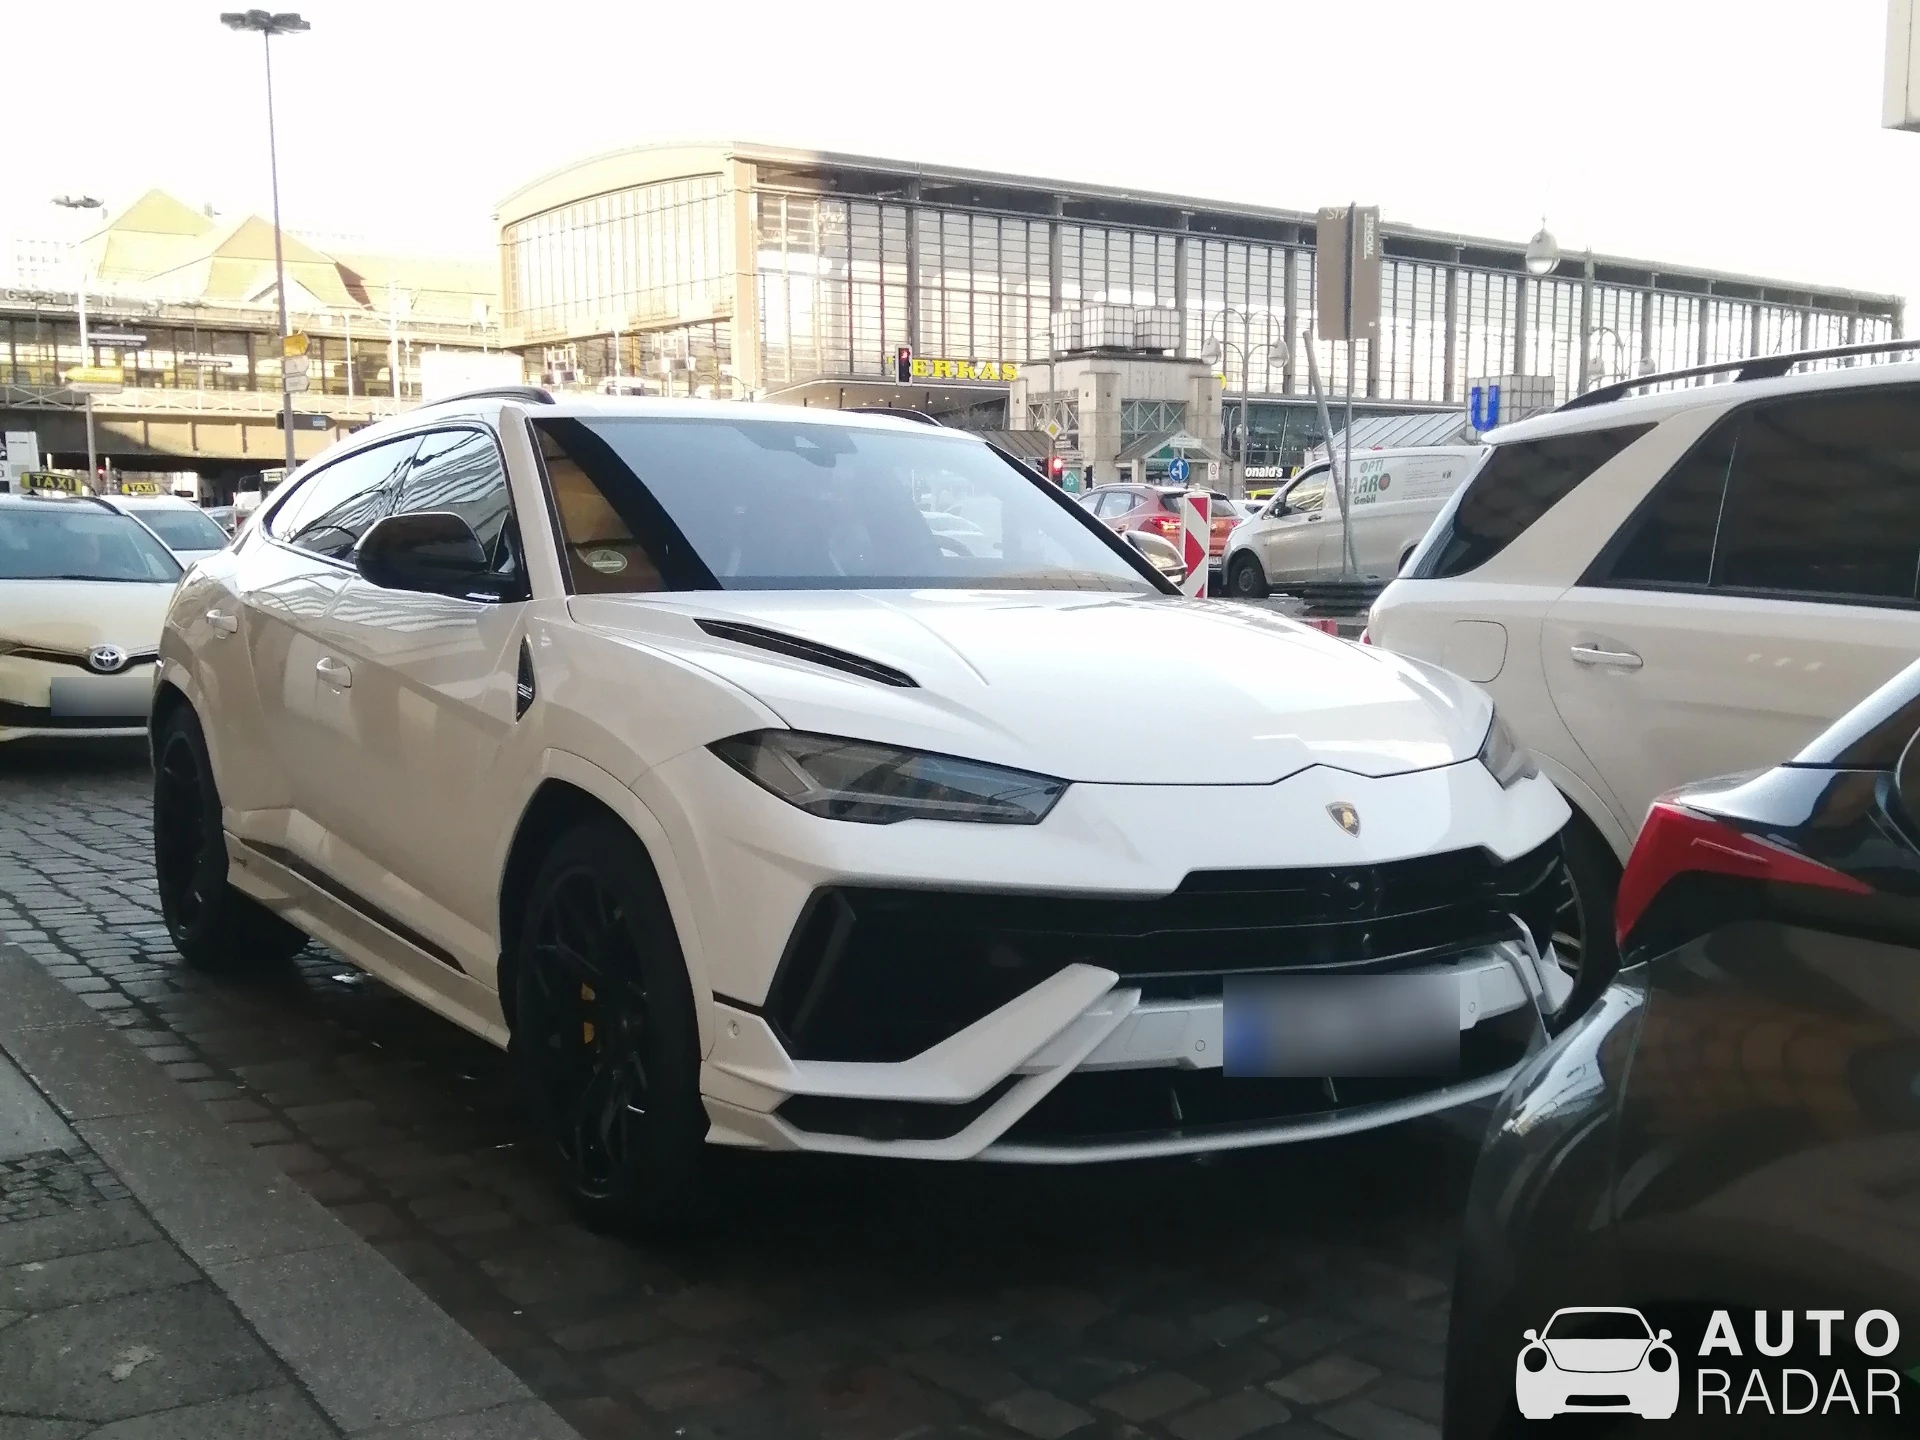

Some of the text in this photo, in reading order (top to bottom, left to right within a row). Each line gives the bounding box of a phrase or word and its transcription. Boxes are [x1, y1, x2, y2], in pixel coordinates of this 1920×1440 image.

[887, 357, 1018, 382] ERRAS
[1471, 384, 1500, 431] U
[1245, 465, 1284, 478] onald's
[34, 475, 73, 490] TAXI
[129, 483, 156, 493] TAXI
[1354, 494, 1376, 505] GmbH
